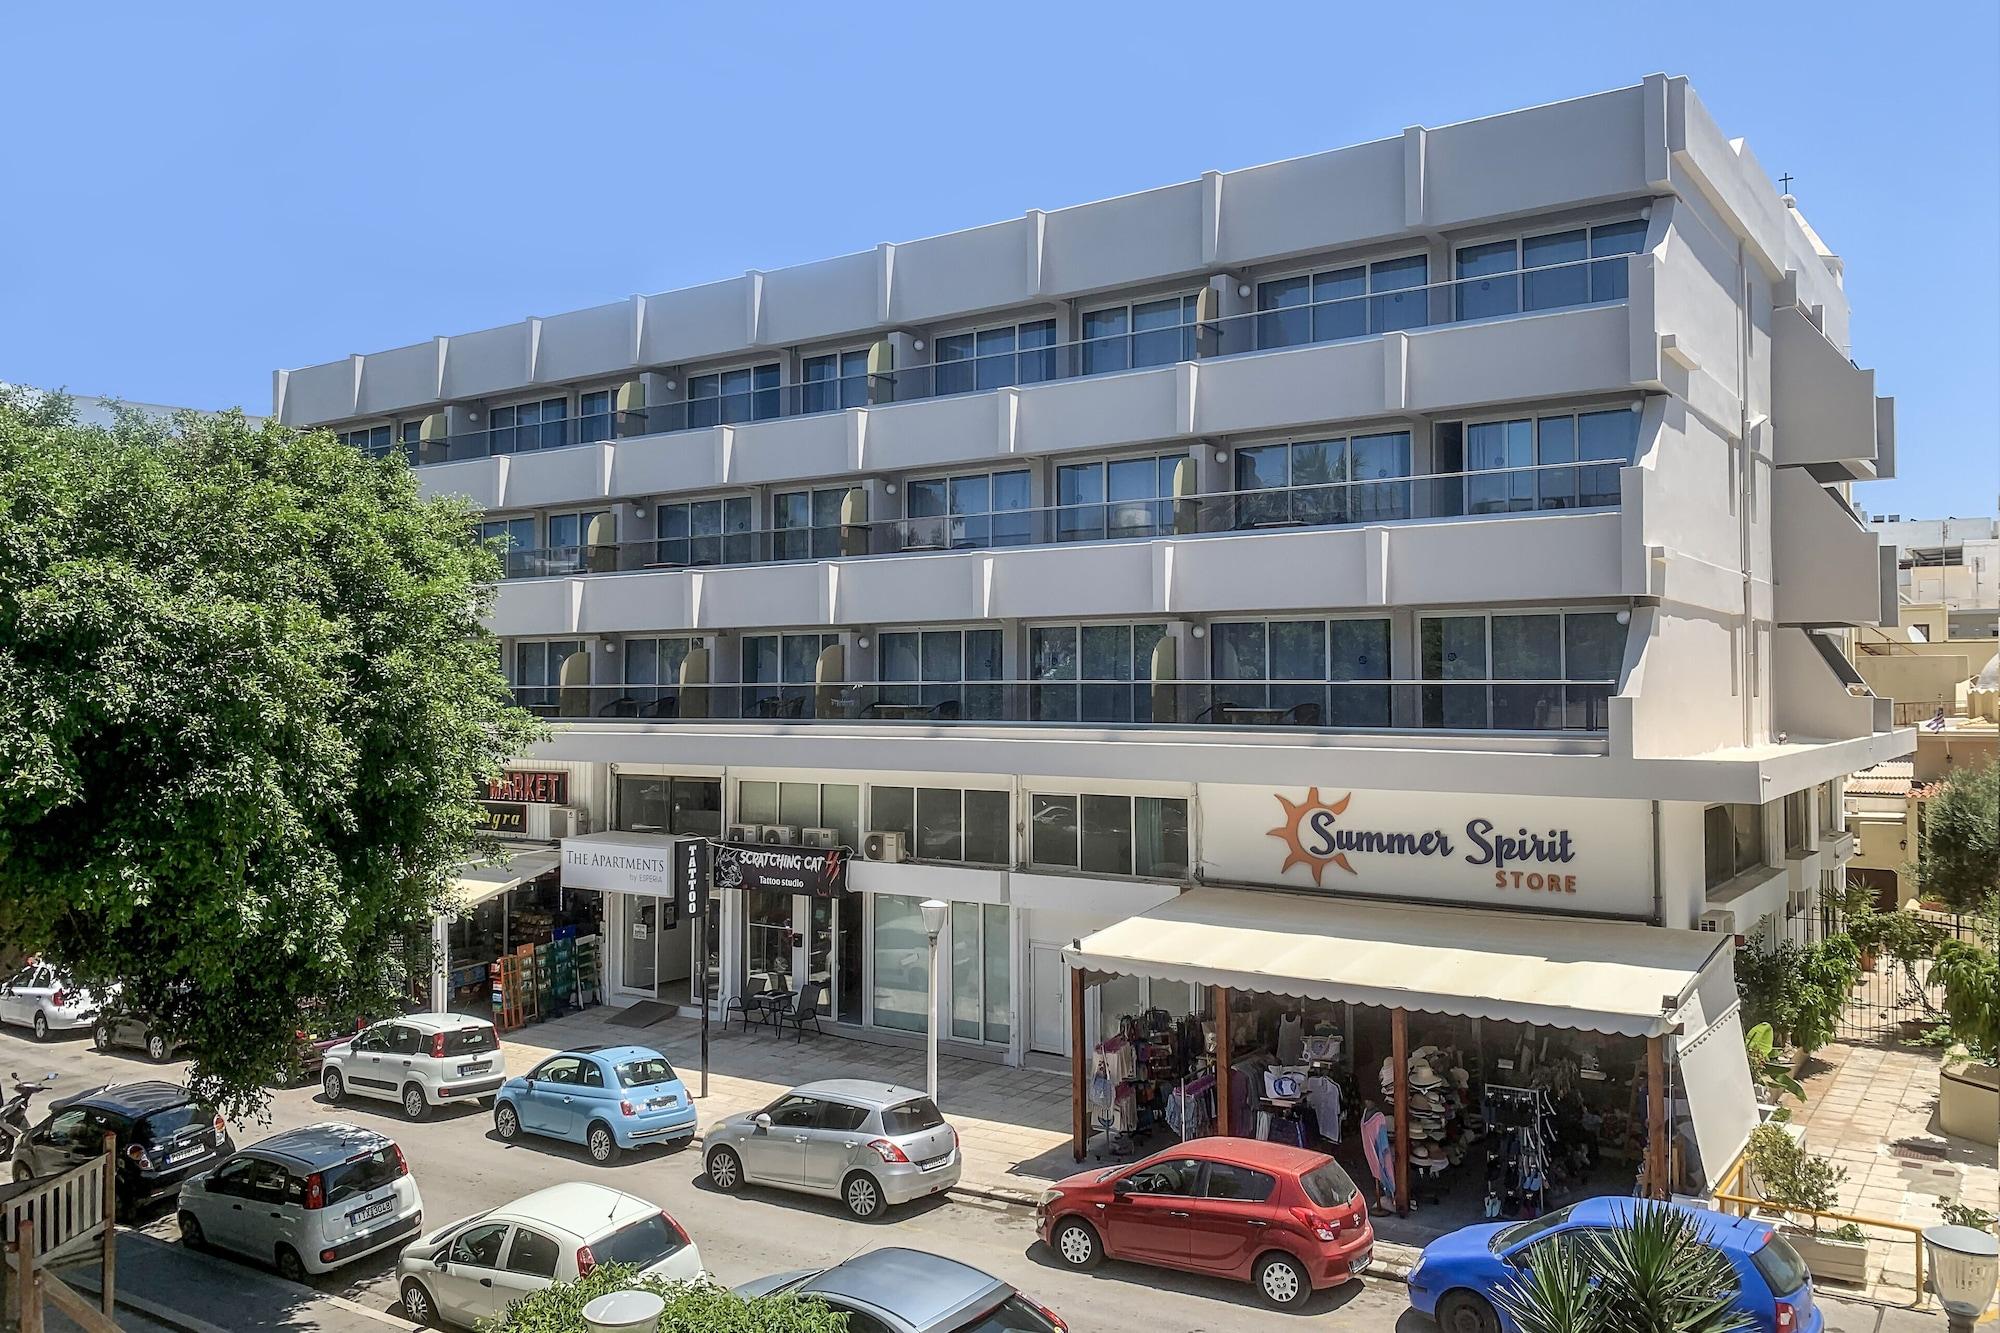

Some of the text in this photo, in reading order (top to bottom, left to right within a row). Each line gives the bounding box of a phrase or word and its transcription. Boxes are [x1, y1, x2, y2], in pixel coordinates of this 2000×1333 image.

[489, 772, 559, 803] MARKET
[1309, 810, 1576, 868] Summer Spirit
[566, 850, 664, 873] THE APARTMENTS
[739, 851, 826, 874] SCRATCHING CAT
[687, 844, 698, 914] TATTOO
[759, 875, 805, 888] Tattoo studio
[1495, 870, 1577, 894] STORE
